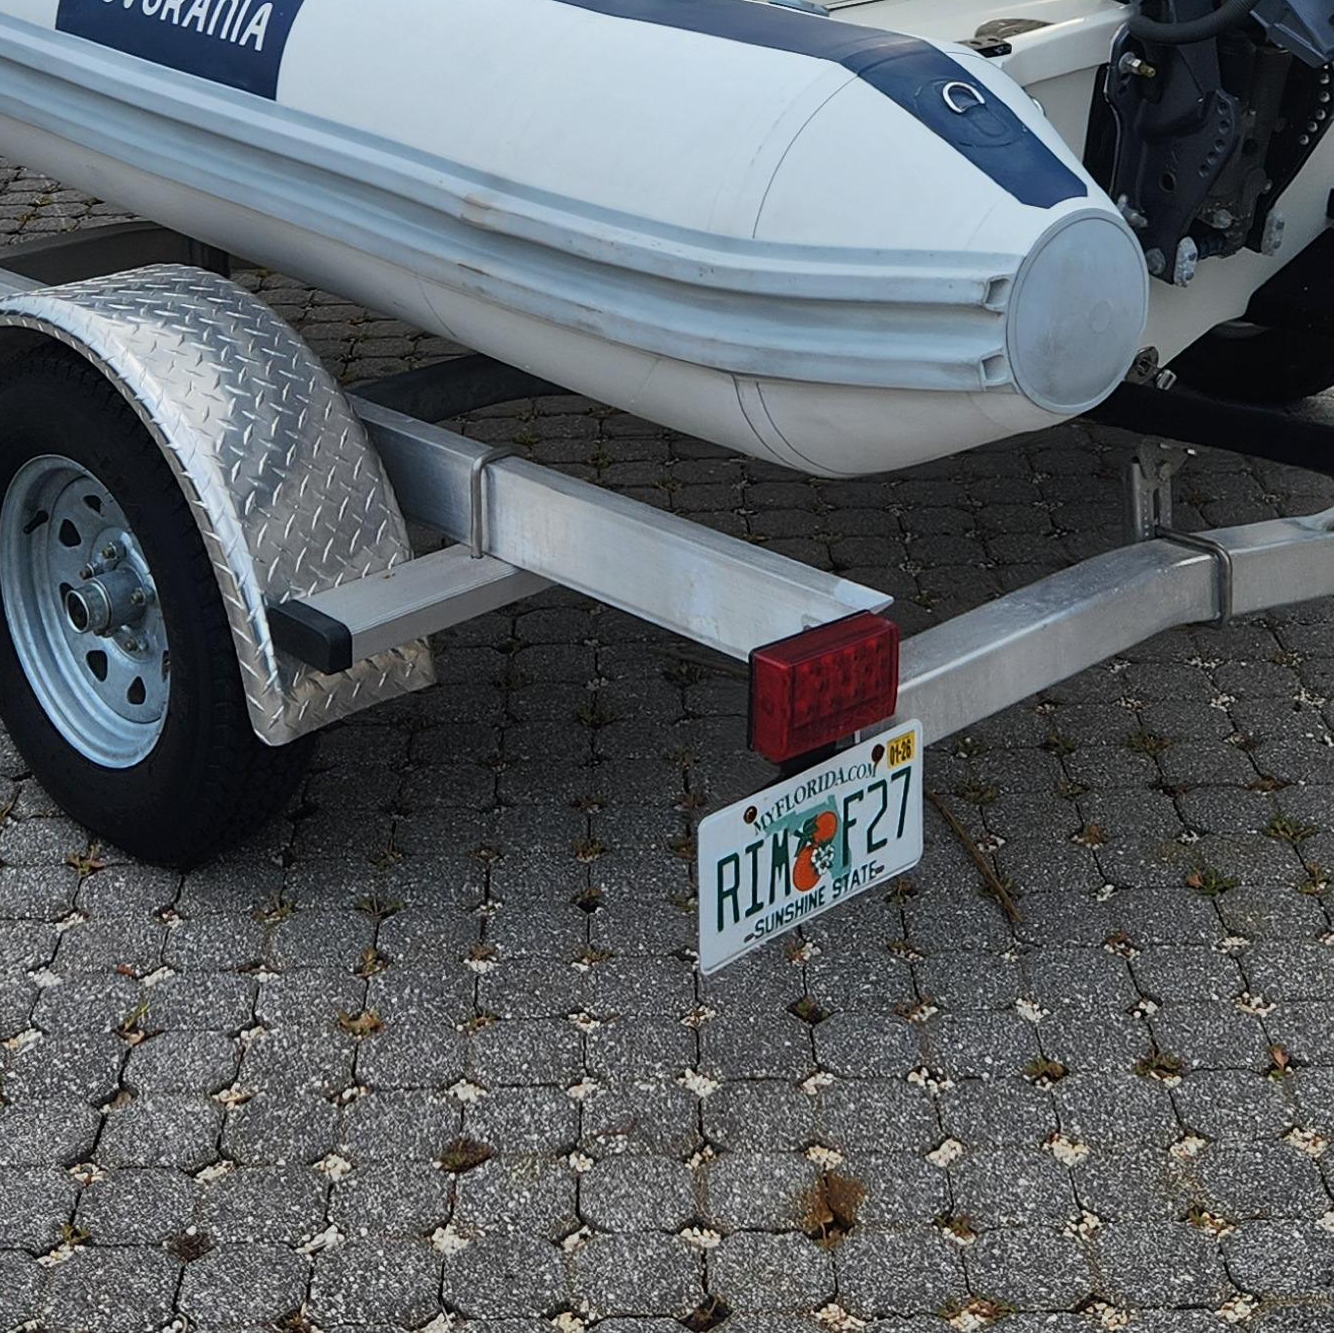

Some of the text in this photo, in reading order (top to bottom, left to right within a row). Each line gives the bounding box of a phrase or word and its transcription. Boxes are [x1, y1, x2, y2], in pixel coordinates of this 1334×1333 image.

[889, 738, 912, 766] 01-26
[753, 763, 877, 835] MYFLORIDA.COM
[717, 766, 912, 932] RIM F27
[754, 860, 878, 939] SUNSHINE STATE
